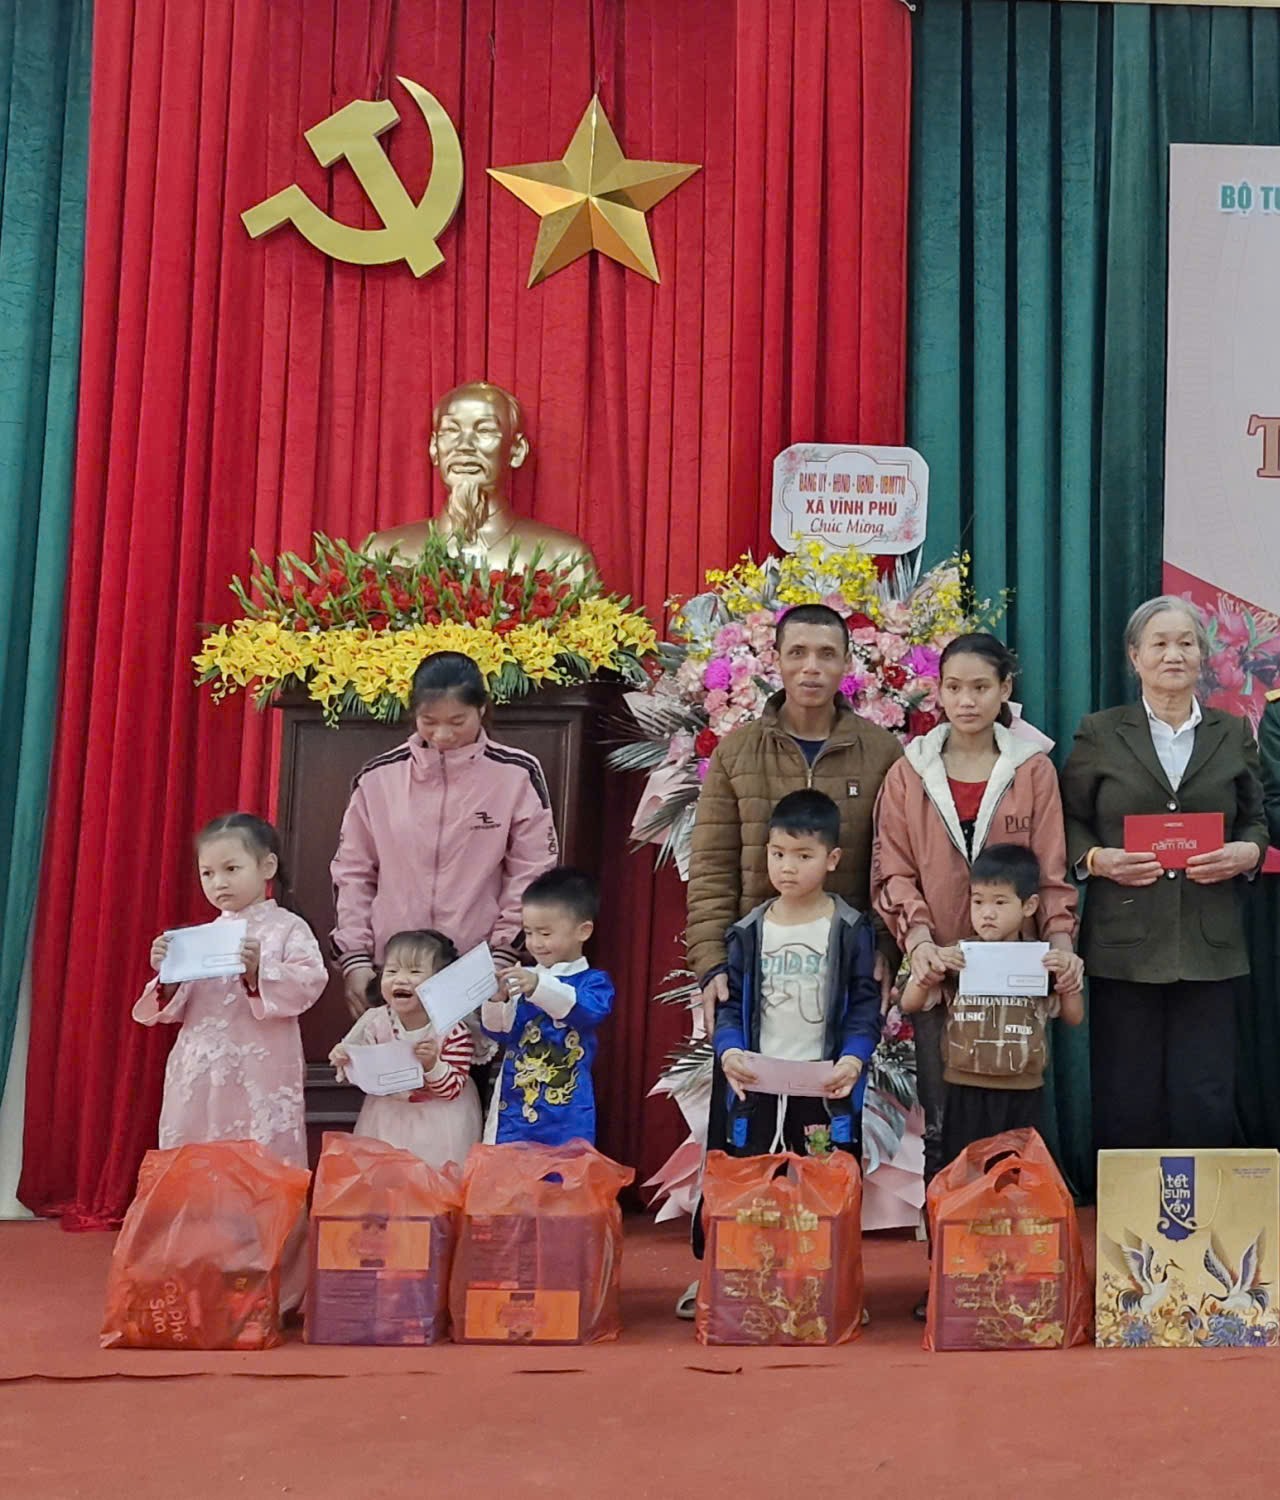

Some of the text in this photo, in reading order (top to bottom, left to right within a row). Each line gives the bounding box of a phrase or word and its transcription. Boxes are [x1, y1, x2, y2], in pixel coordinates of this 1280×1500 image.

[1220, 182, 1252, 214] BỘ
[806, 495, 897, 516] XÃ VĨNH PHÚ
[810, 517, 842, 534] Chúc
[1164, 1188, 1191, 1199] sum
